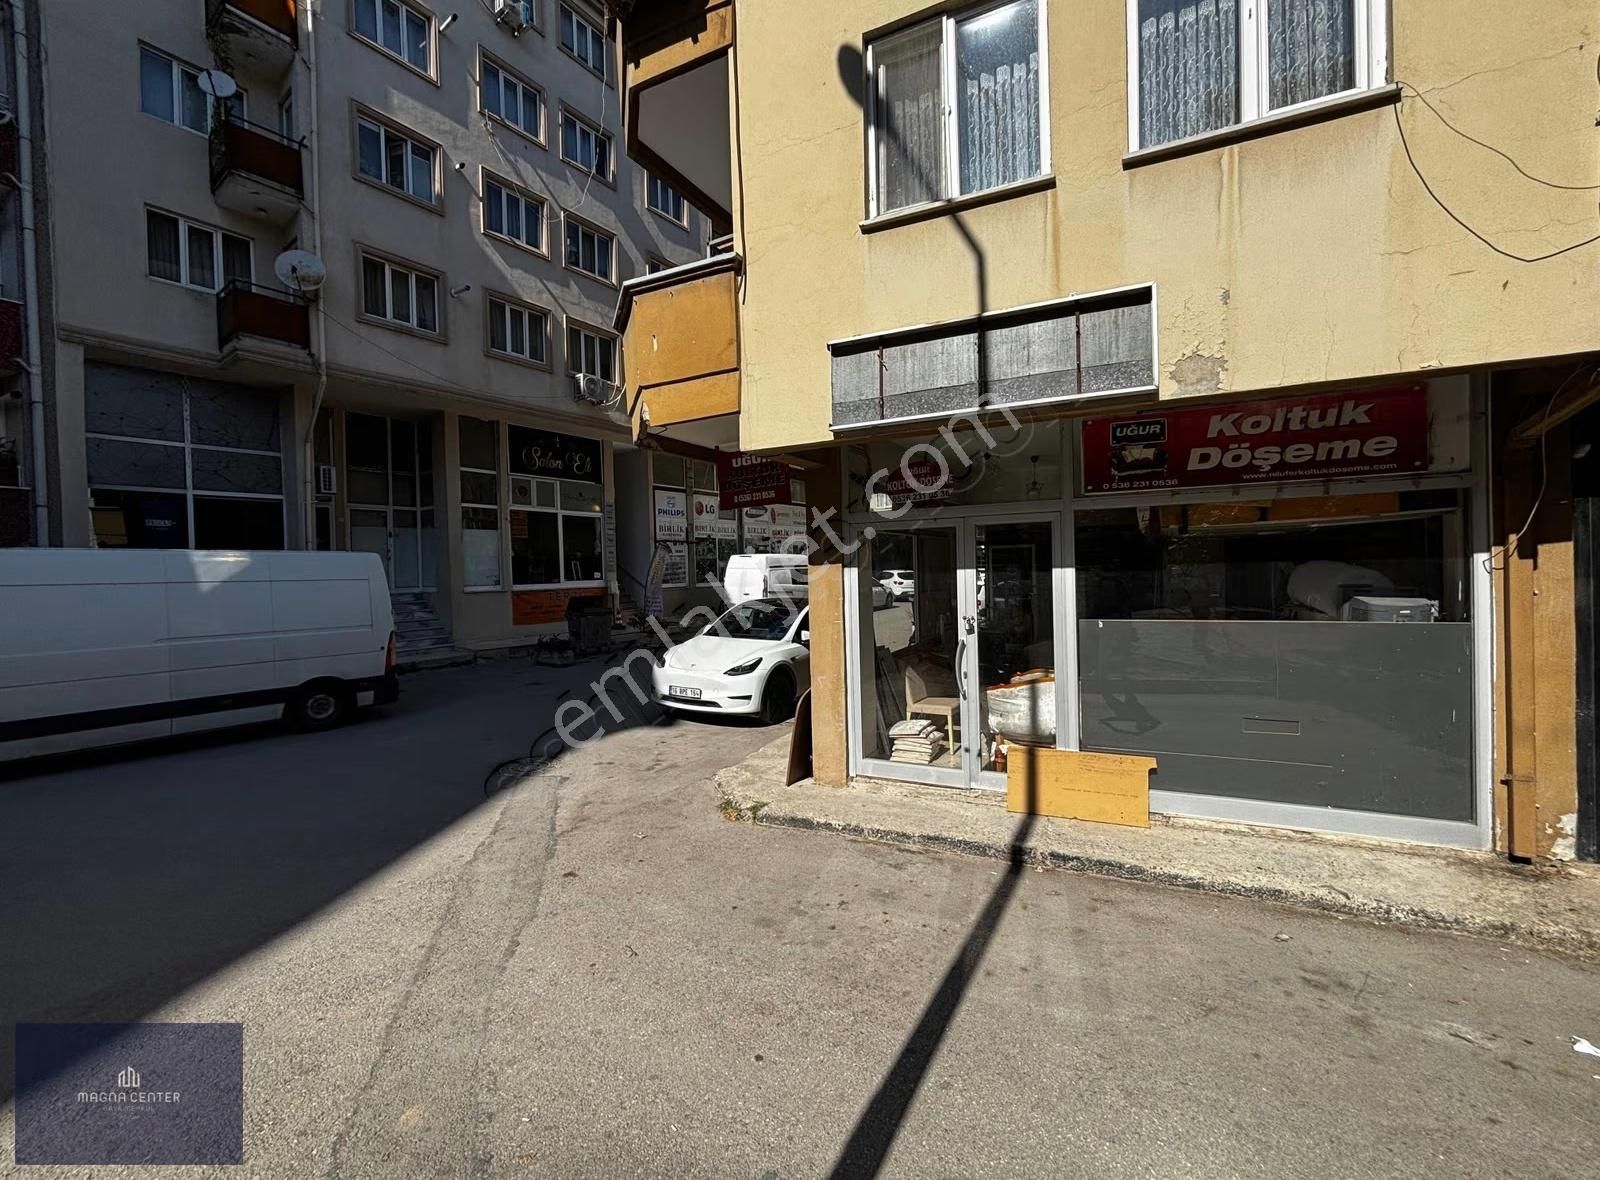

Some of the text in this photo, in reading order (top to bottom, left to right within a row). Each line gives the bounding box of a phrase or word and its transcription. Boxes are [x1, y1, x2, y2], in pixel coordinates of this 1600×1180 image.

[1206, 400, 1371, 439] Koltuk
[1115, 423, 1162, 438] UĞUR
[522, 446, 562, 470] Salon
[1186, 435, 1399, 471] Döşeme
[732, 454, 771, 468] UĞU
[657, 508, 685, 517] PHILIPS
[705, 504, 715, 514] LG
